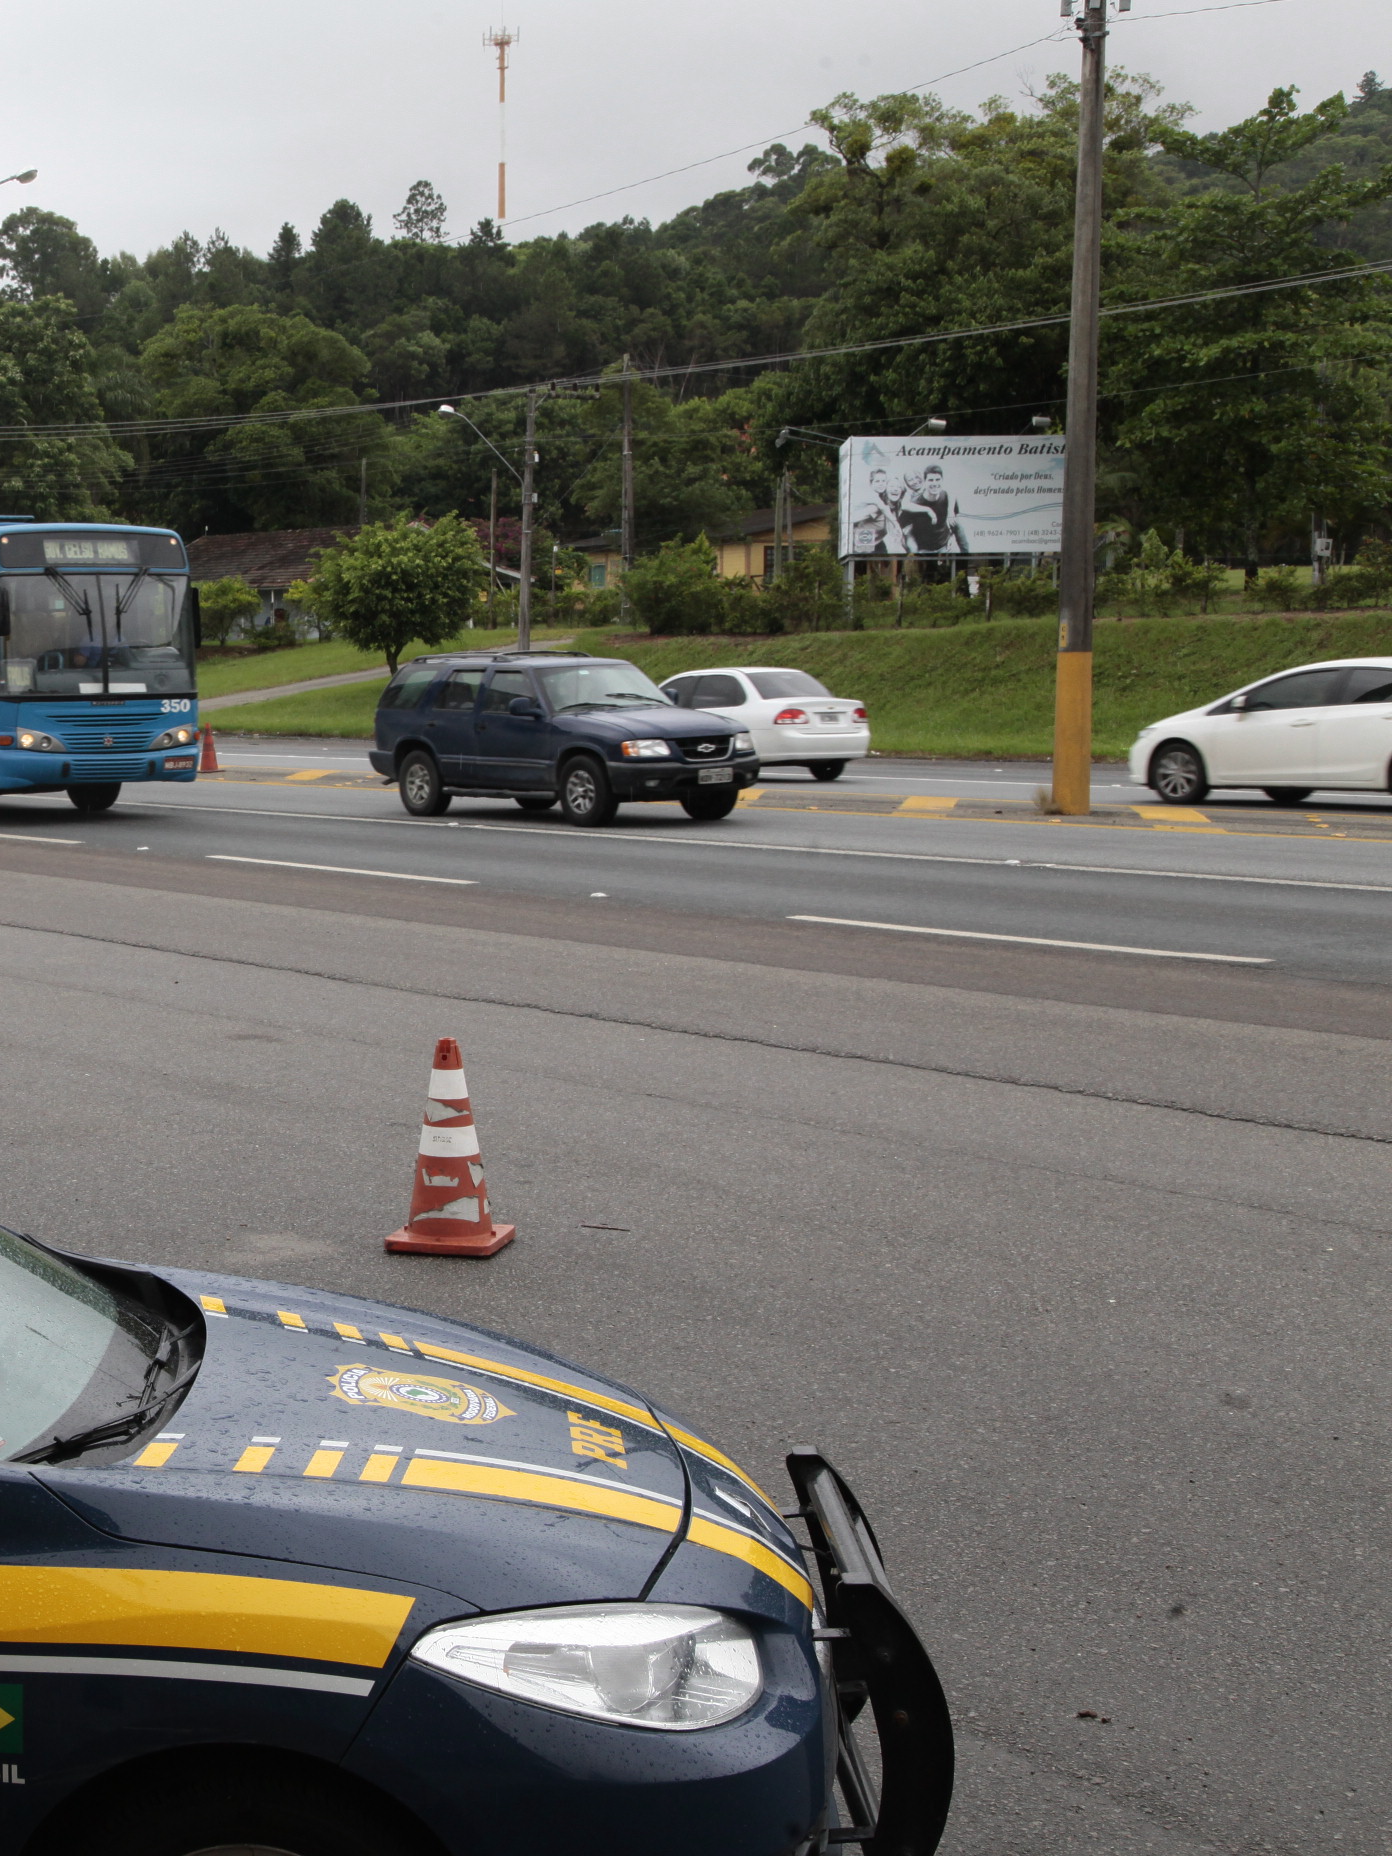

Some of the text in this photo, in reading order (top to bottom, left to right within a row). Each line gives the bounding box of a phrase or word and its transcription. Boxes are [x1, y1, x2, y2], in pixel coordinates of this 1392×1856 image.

[896, 442, 1066, 459] Acampamento Batist
[1019, 473, 1034, 482] por
[973, 486, 1014, 496] desfrutado
[1015, 485, 1035, 496] pelos
[160, 699, 191, 713] 350
[566, 1410, 628, 1470] PRF
